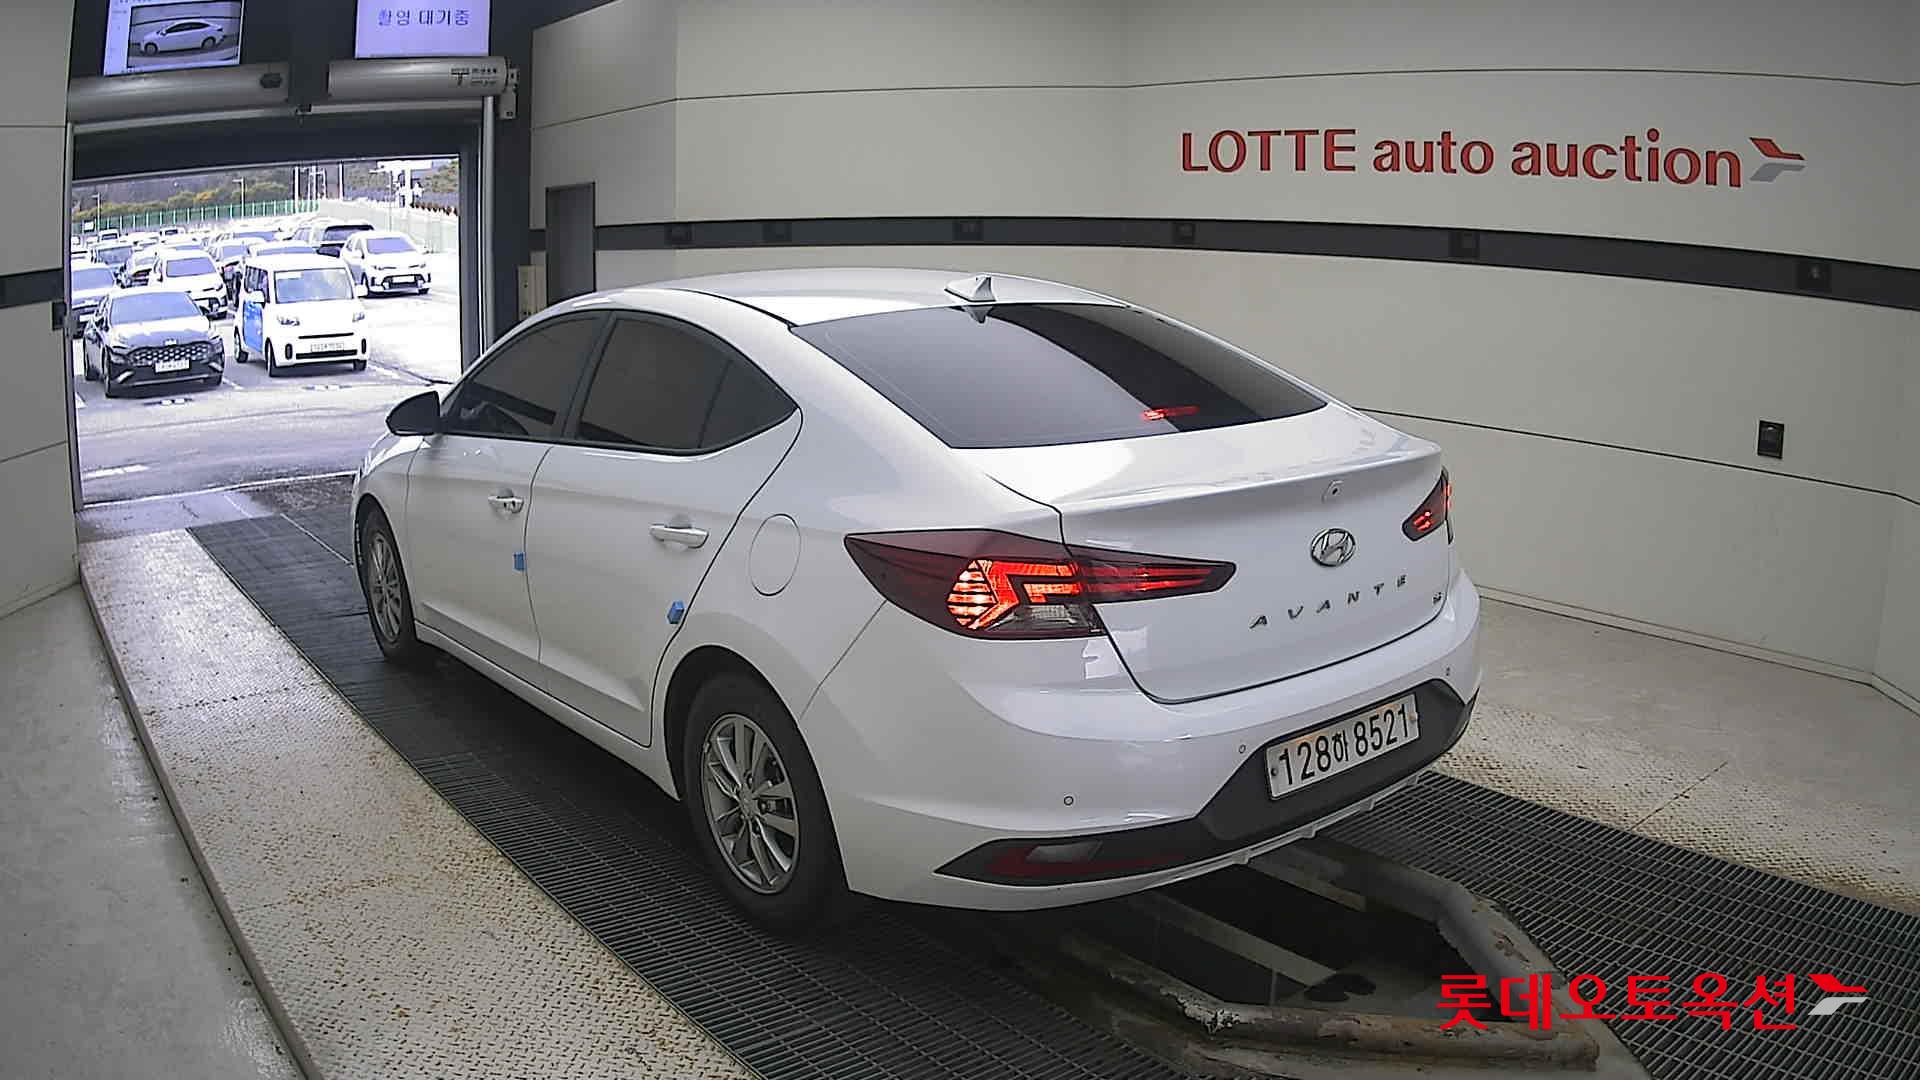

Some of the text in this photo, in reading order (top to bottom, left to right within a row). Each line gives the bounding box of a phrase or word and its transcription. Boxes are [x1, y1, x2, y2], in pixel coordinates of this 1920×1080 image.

[418, 9, 470, 26] 대기중
[1182, 128, 1743, 188] LOTTE auto auction
[1249, 575, 1407, 629] AVANTE
[1353, 703, 1409, 757] 8521
